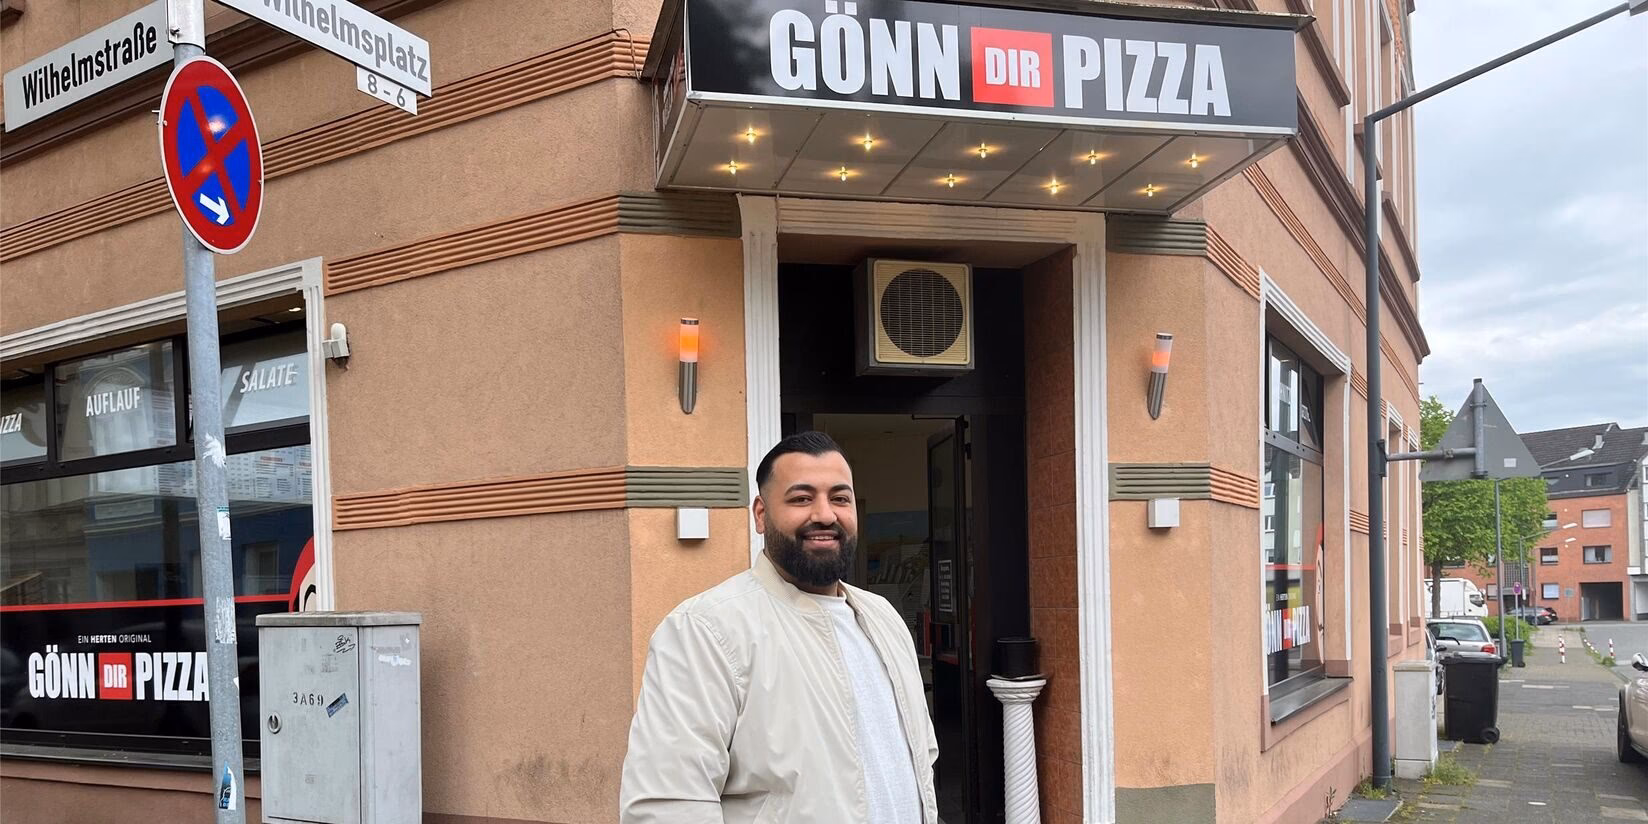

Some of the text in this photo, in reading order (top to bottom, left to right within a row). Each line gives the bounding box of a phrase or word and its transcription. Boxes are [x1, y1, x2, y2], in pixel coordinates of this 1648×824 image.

[22, 22, 157, 109] Wilhelmstraße
[769, 0, 961, 100] GÖNN
[984, 46, 1041, 89] DIR
[1063, 34, 1231, 117] PIZZA
[367, 73, 378, 94] 8
[396, 88, 406, 108] 6
[239, 363, 296, 393] SALATE
[86, 387, 141, 417] AUFLAUF
[77, 634, 152, 644] EIN HERTEN ORIGINAL
[28, 644, 210, 701] GÖNN DIR PIZZA
[292, 692, 324, 706] 3A69
